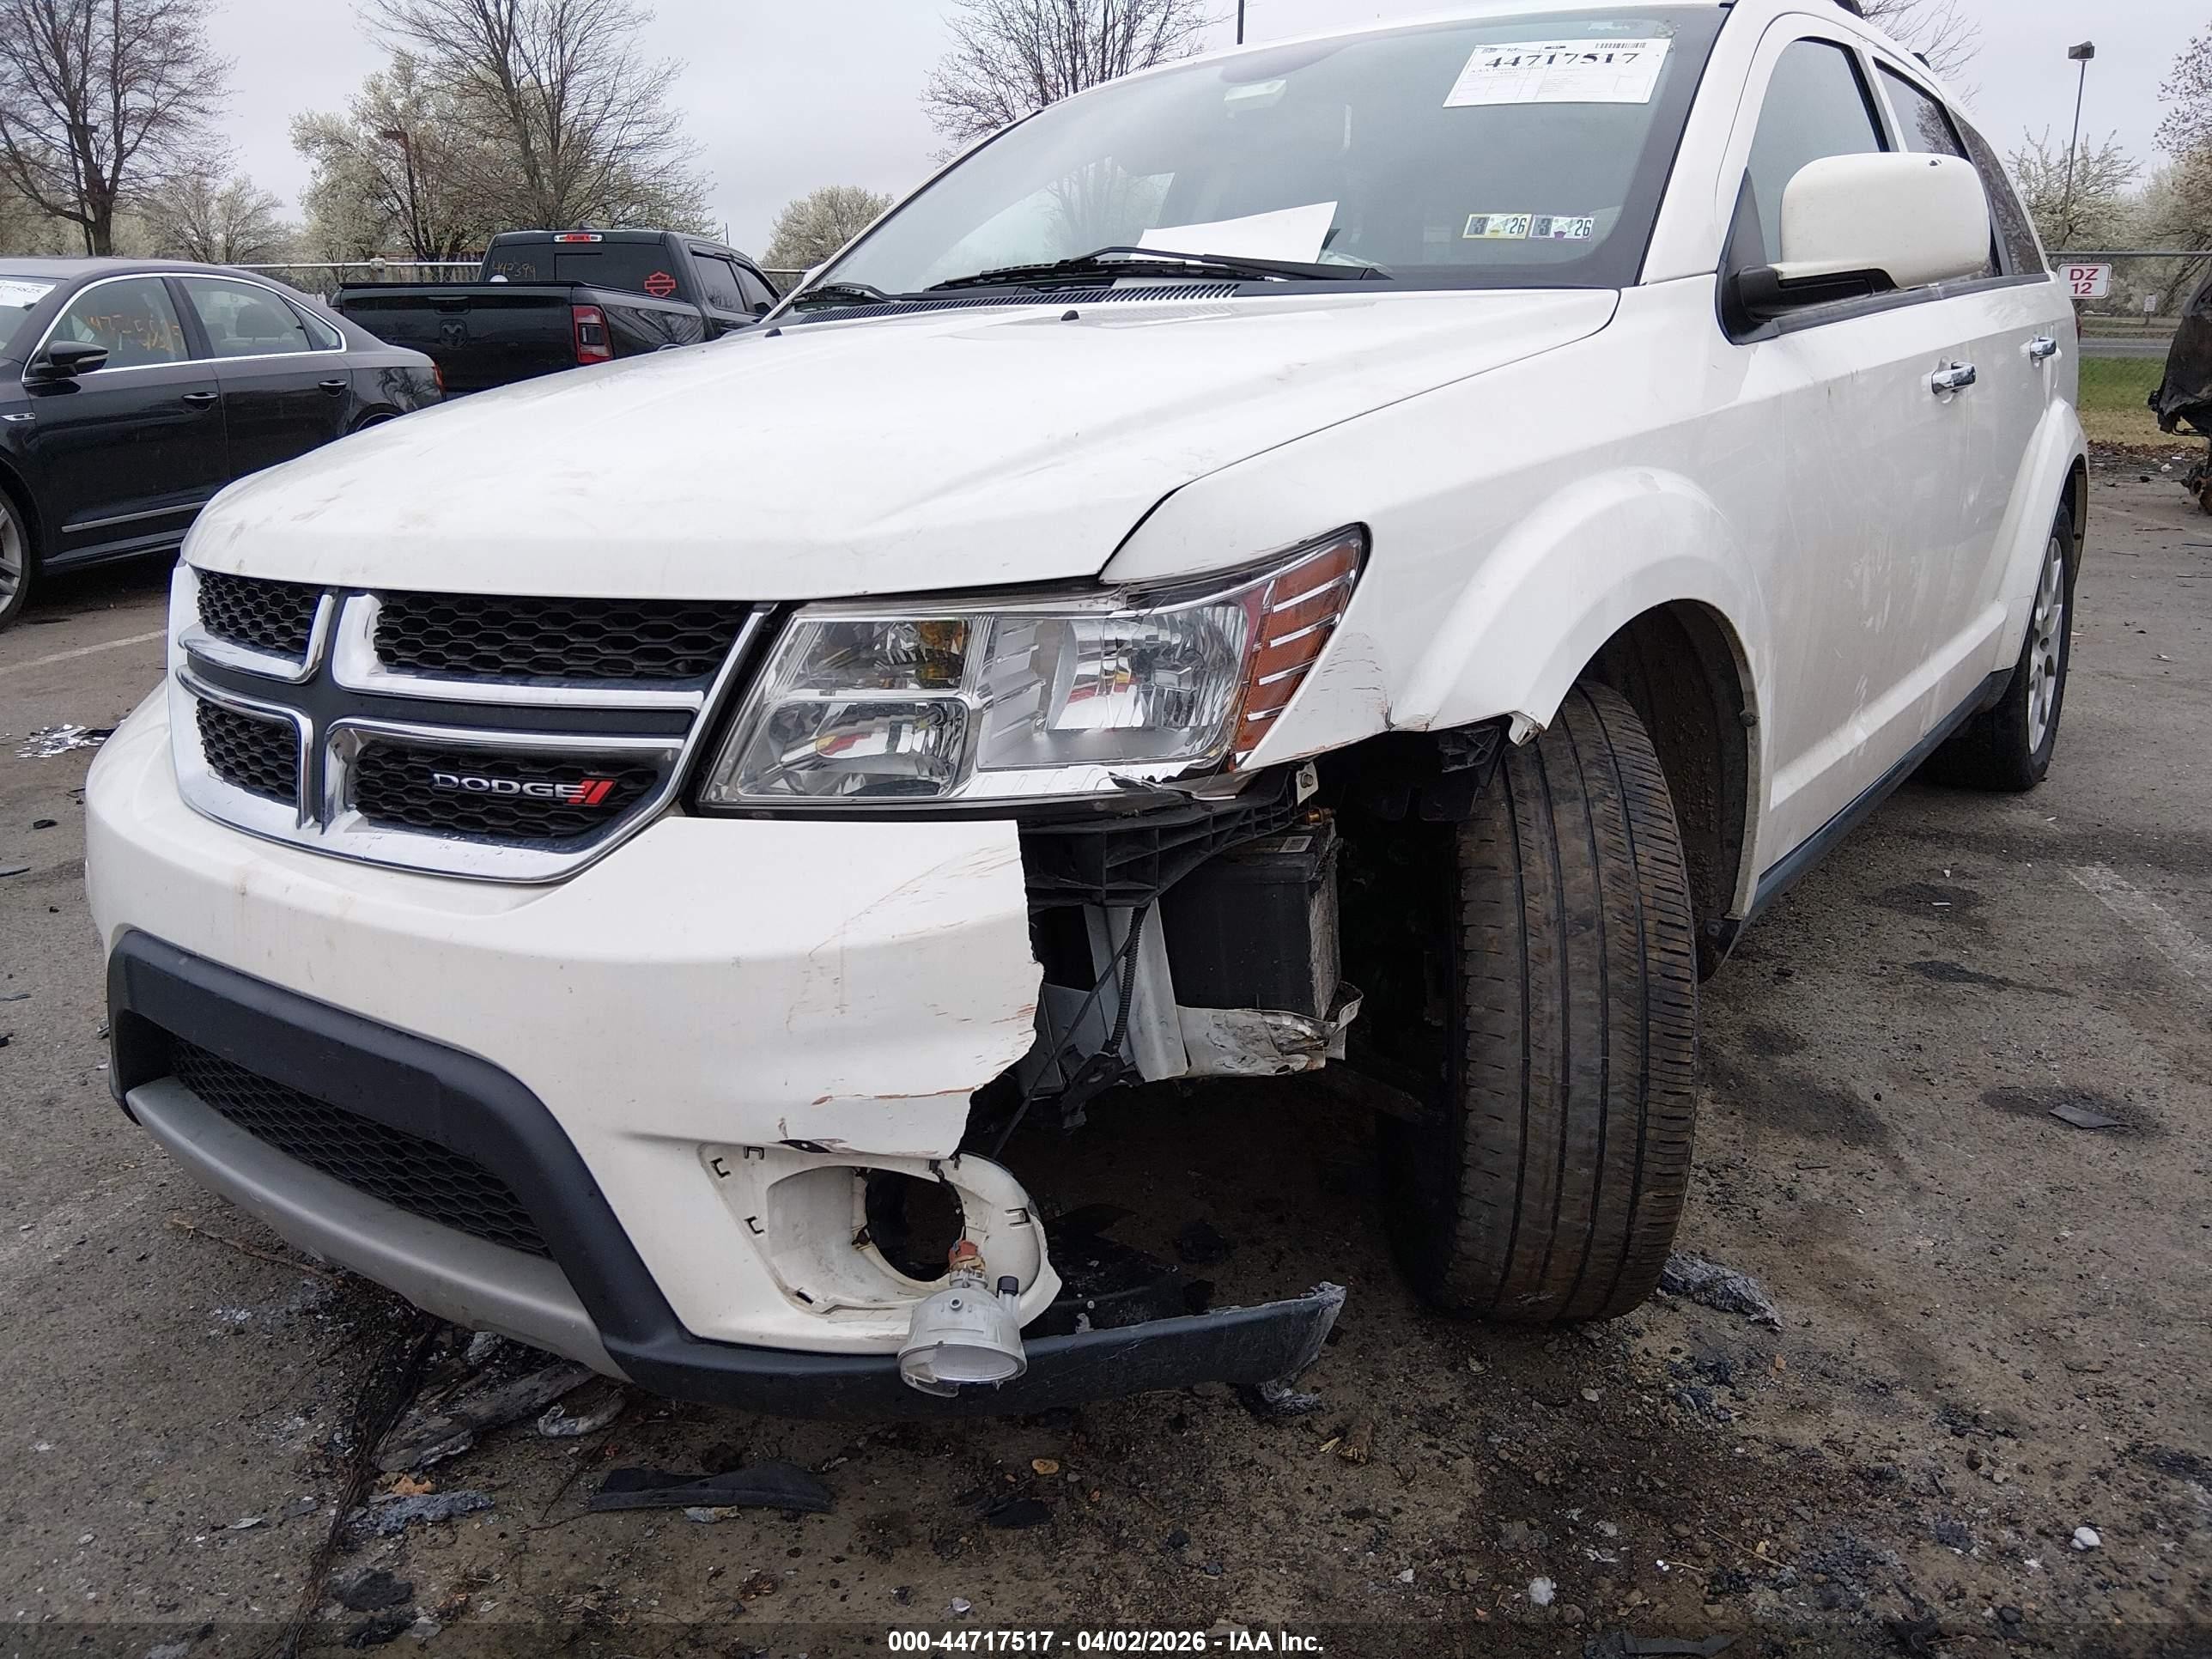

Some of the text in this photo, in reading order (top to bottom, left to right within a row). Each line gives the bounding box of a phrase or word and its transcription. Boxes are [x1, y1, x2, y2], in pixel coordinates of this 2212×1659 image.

[1485, 52, 1640, 68] 44717517
[1510, 217, 1527, 234] 26
[1574, 219, 1591, 236] 26
[2069, 268, 2099, 281] DZ
[2071, 282, 2093, 294] 12
[433, 773, 586, 799] DODGE
